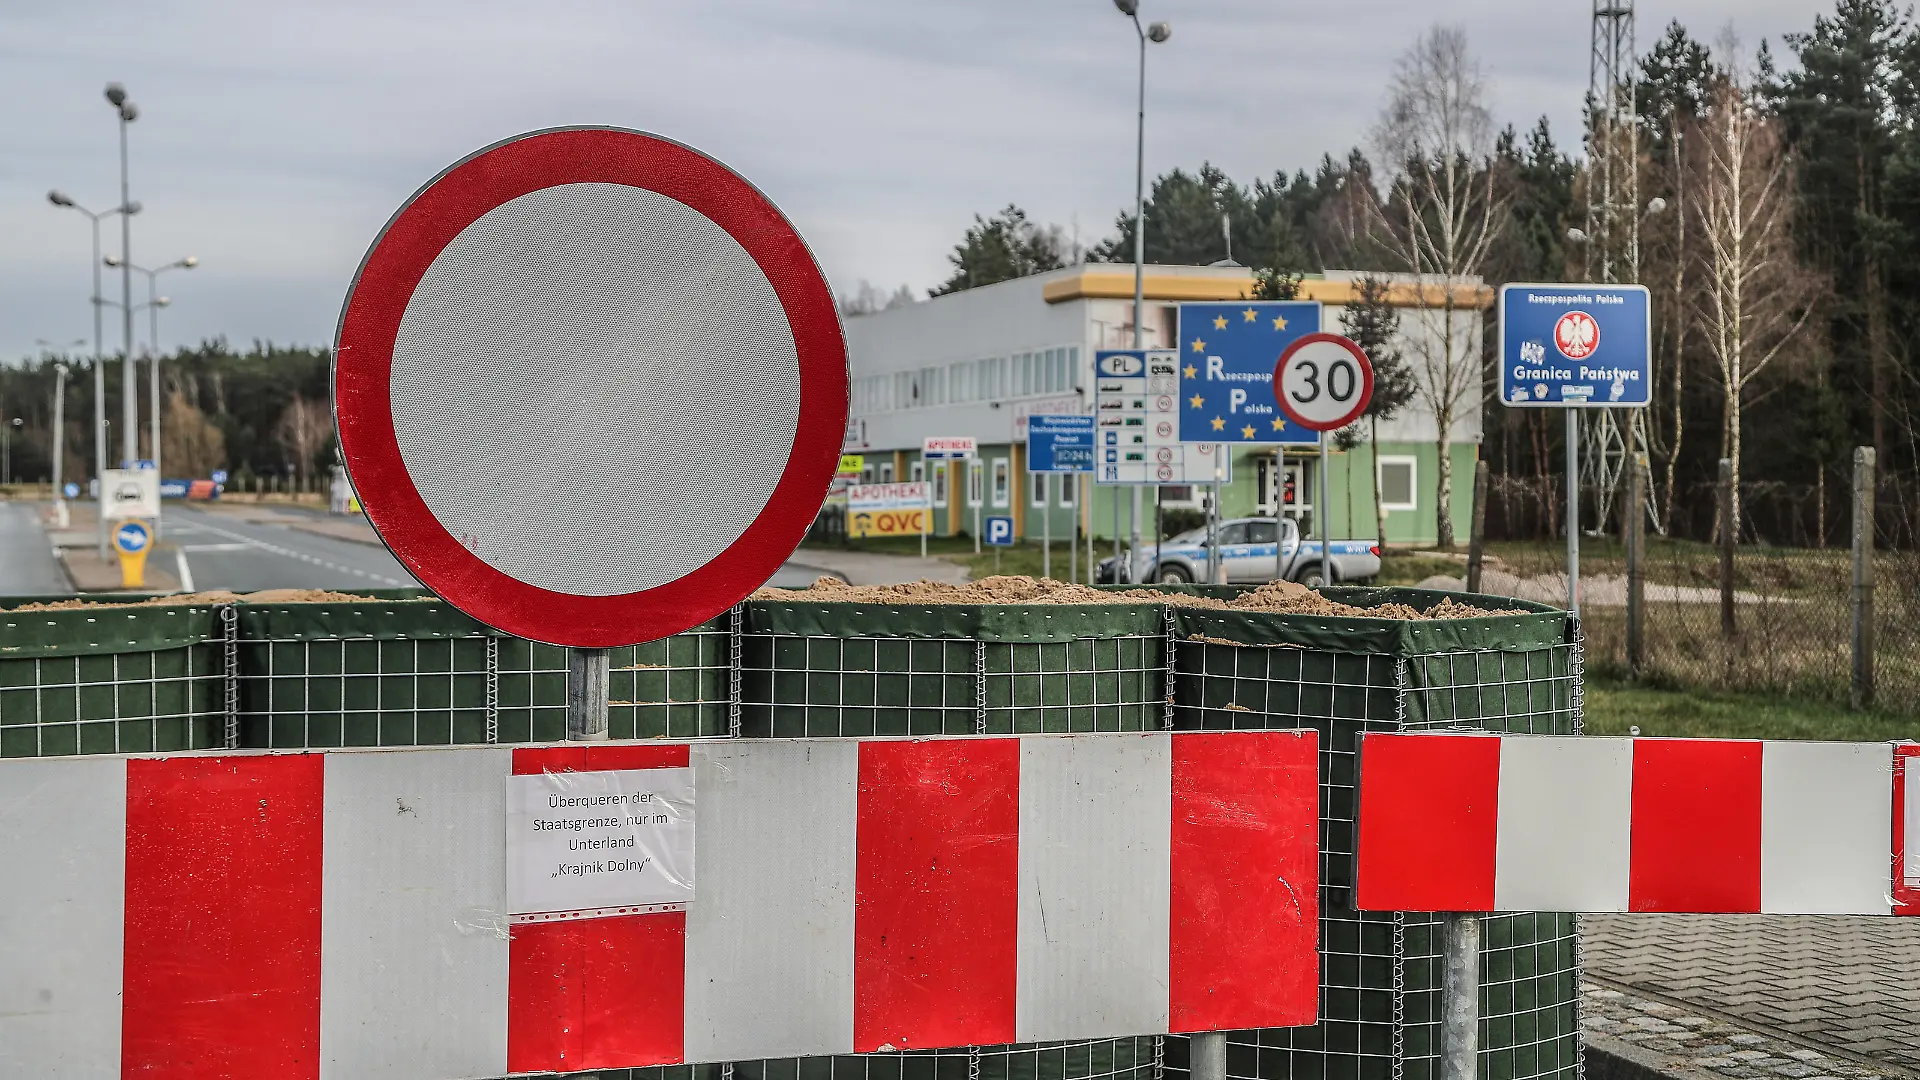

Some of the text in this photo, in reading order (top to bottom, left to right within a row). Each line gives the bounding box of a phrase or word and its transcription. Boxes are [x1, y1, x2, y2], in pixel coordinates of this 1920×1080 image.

[1528, 293, 1624, 306] Rzeczpospolita Polska
[1113, 357, 1131, 372] PL
[1207, 355, 1273, 383] Rzeczposp
[1513, 366, 1640, 381] Granica Państwa
[1291, 359, 1356, 403] 30
[1230, 388, 1273, 414] Polska
[852, 482, 926, 499] APOTHEKE
[991, 519, 1009, 544] P
[548, 791, 653, 809] Überqueren der
[533, 812, 668, 831] Staatsgrenze, nur im
[569, 835, 634, 850] Unterland
[551, 857, 651, 878] „Krajnik Dolny“
